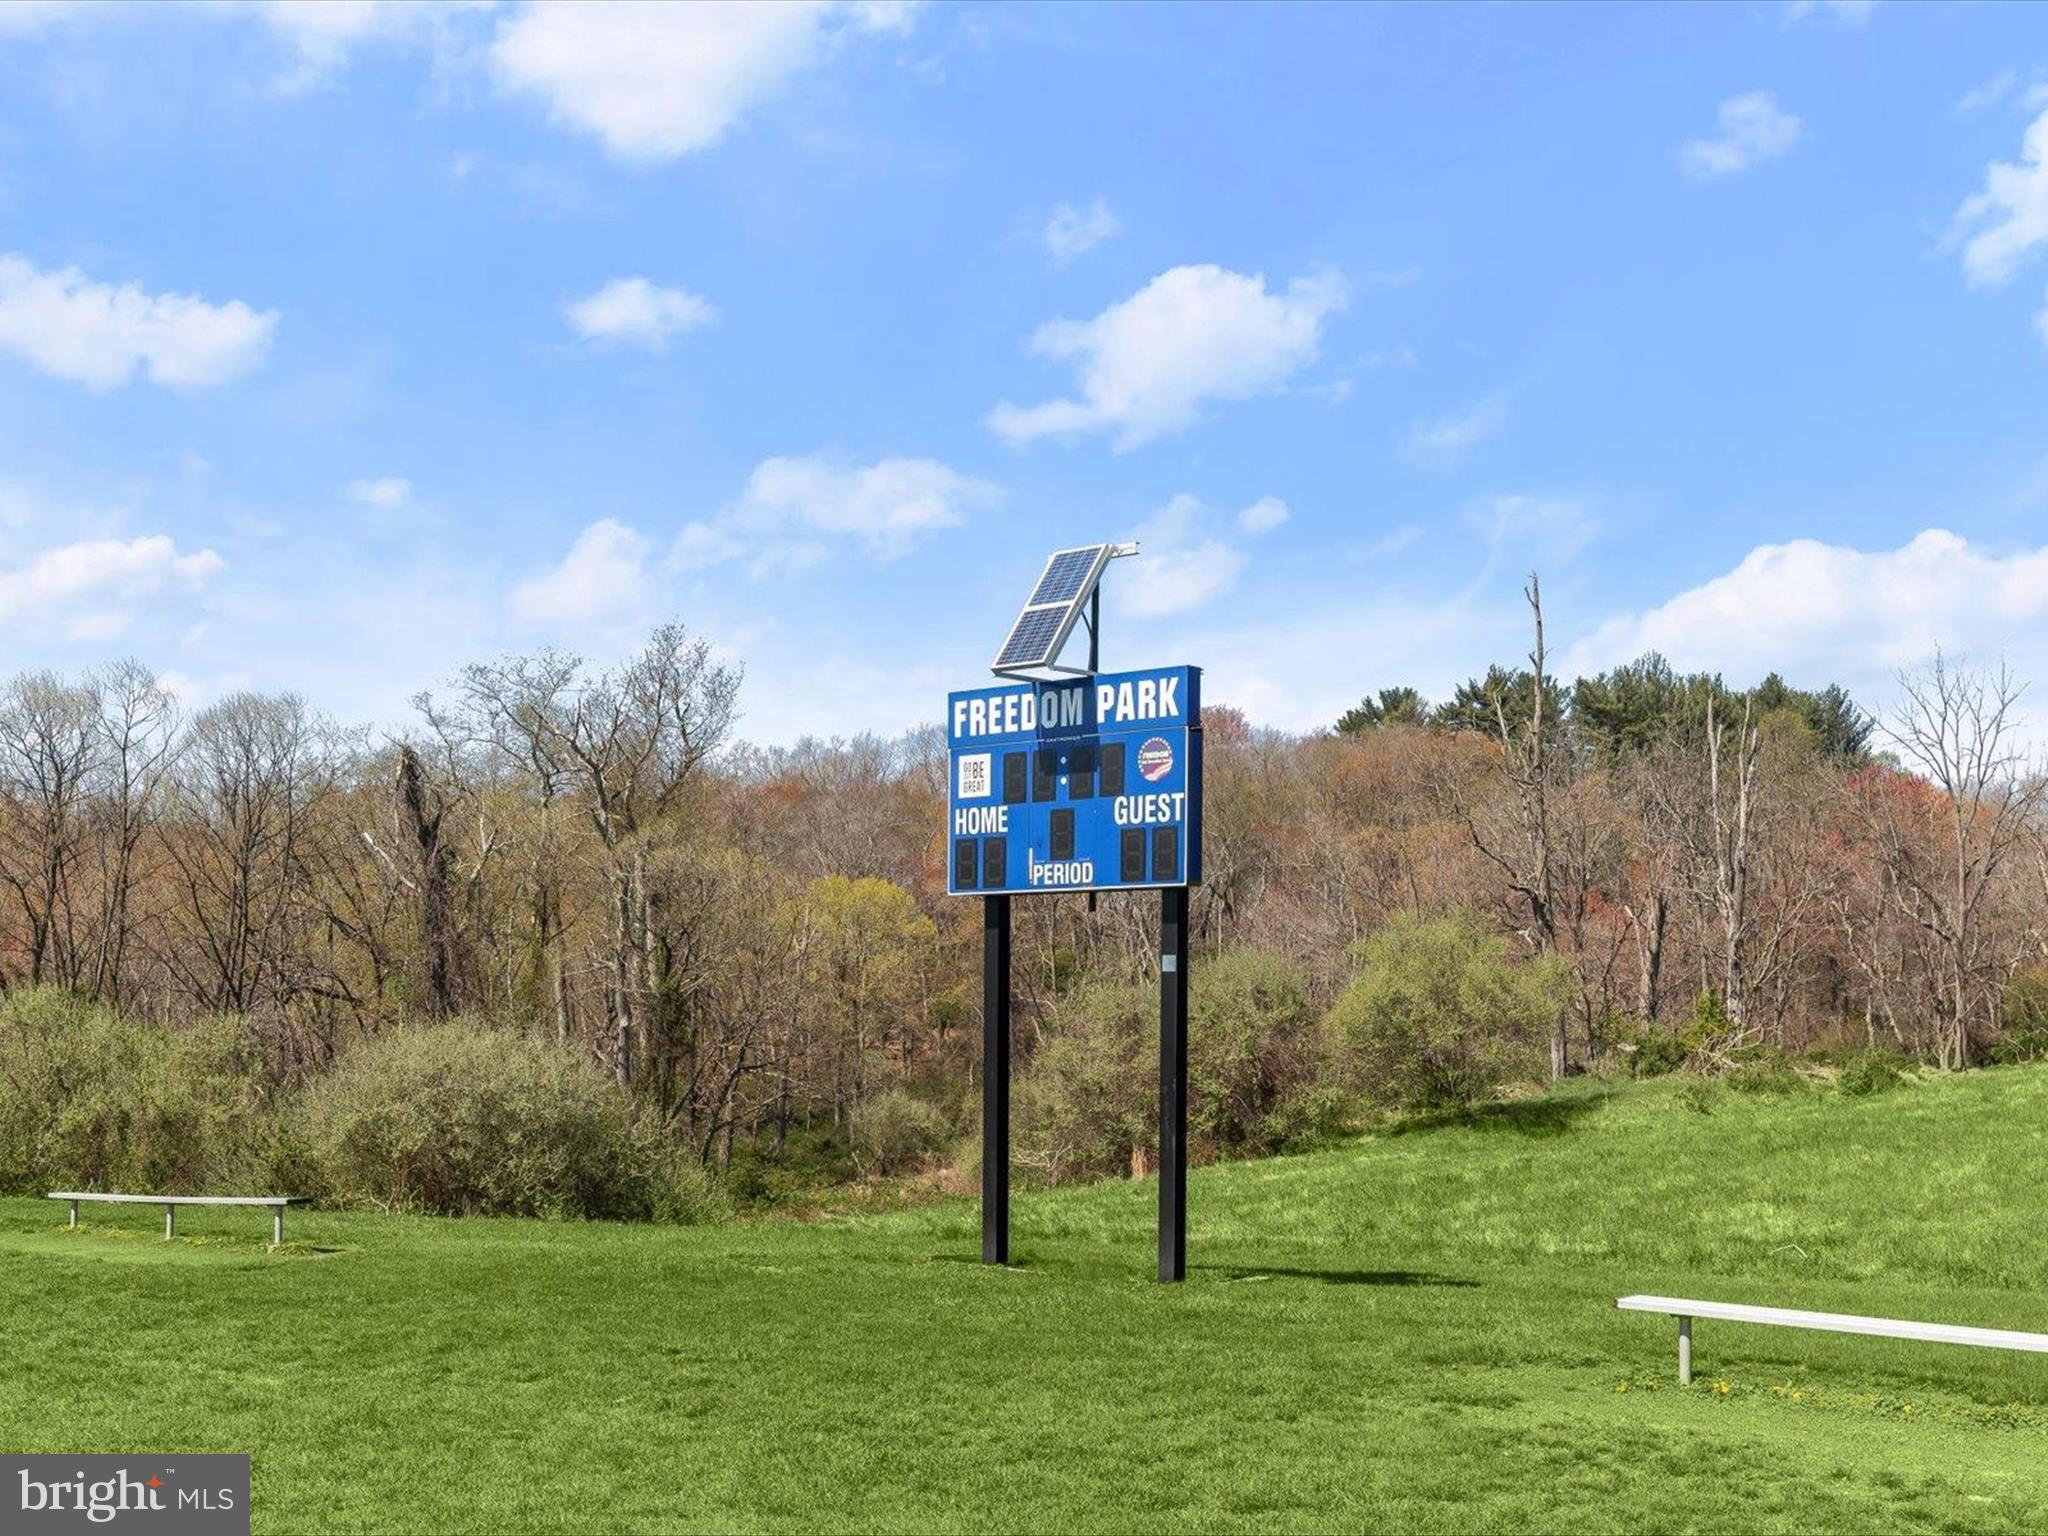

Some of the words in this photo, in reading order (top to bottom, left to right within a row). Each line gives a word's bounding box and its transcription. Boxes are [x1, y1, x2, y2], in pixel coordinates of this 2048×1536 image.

[954, 687, 1083, 738] FREEDOM
[1097, 676, 1179, 723] PARK
[973, 761, 984, 779] BE
[955, 806, 1008, 835] HOME
[1114, 793, 1185, 825] GUEST
[1033, 861, 1094, 885] PERIOD
